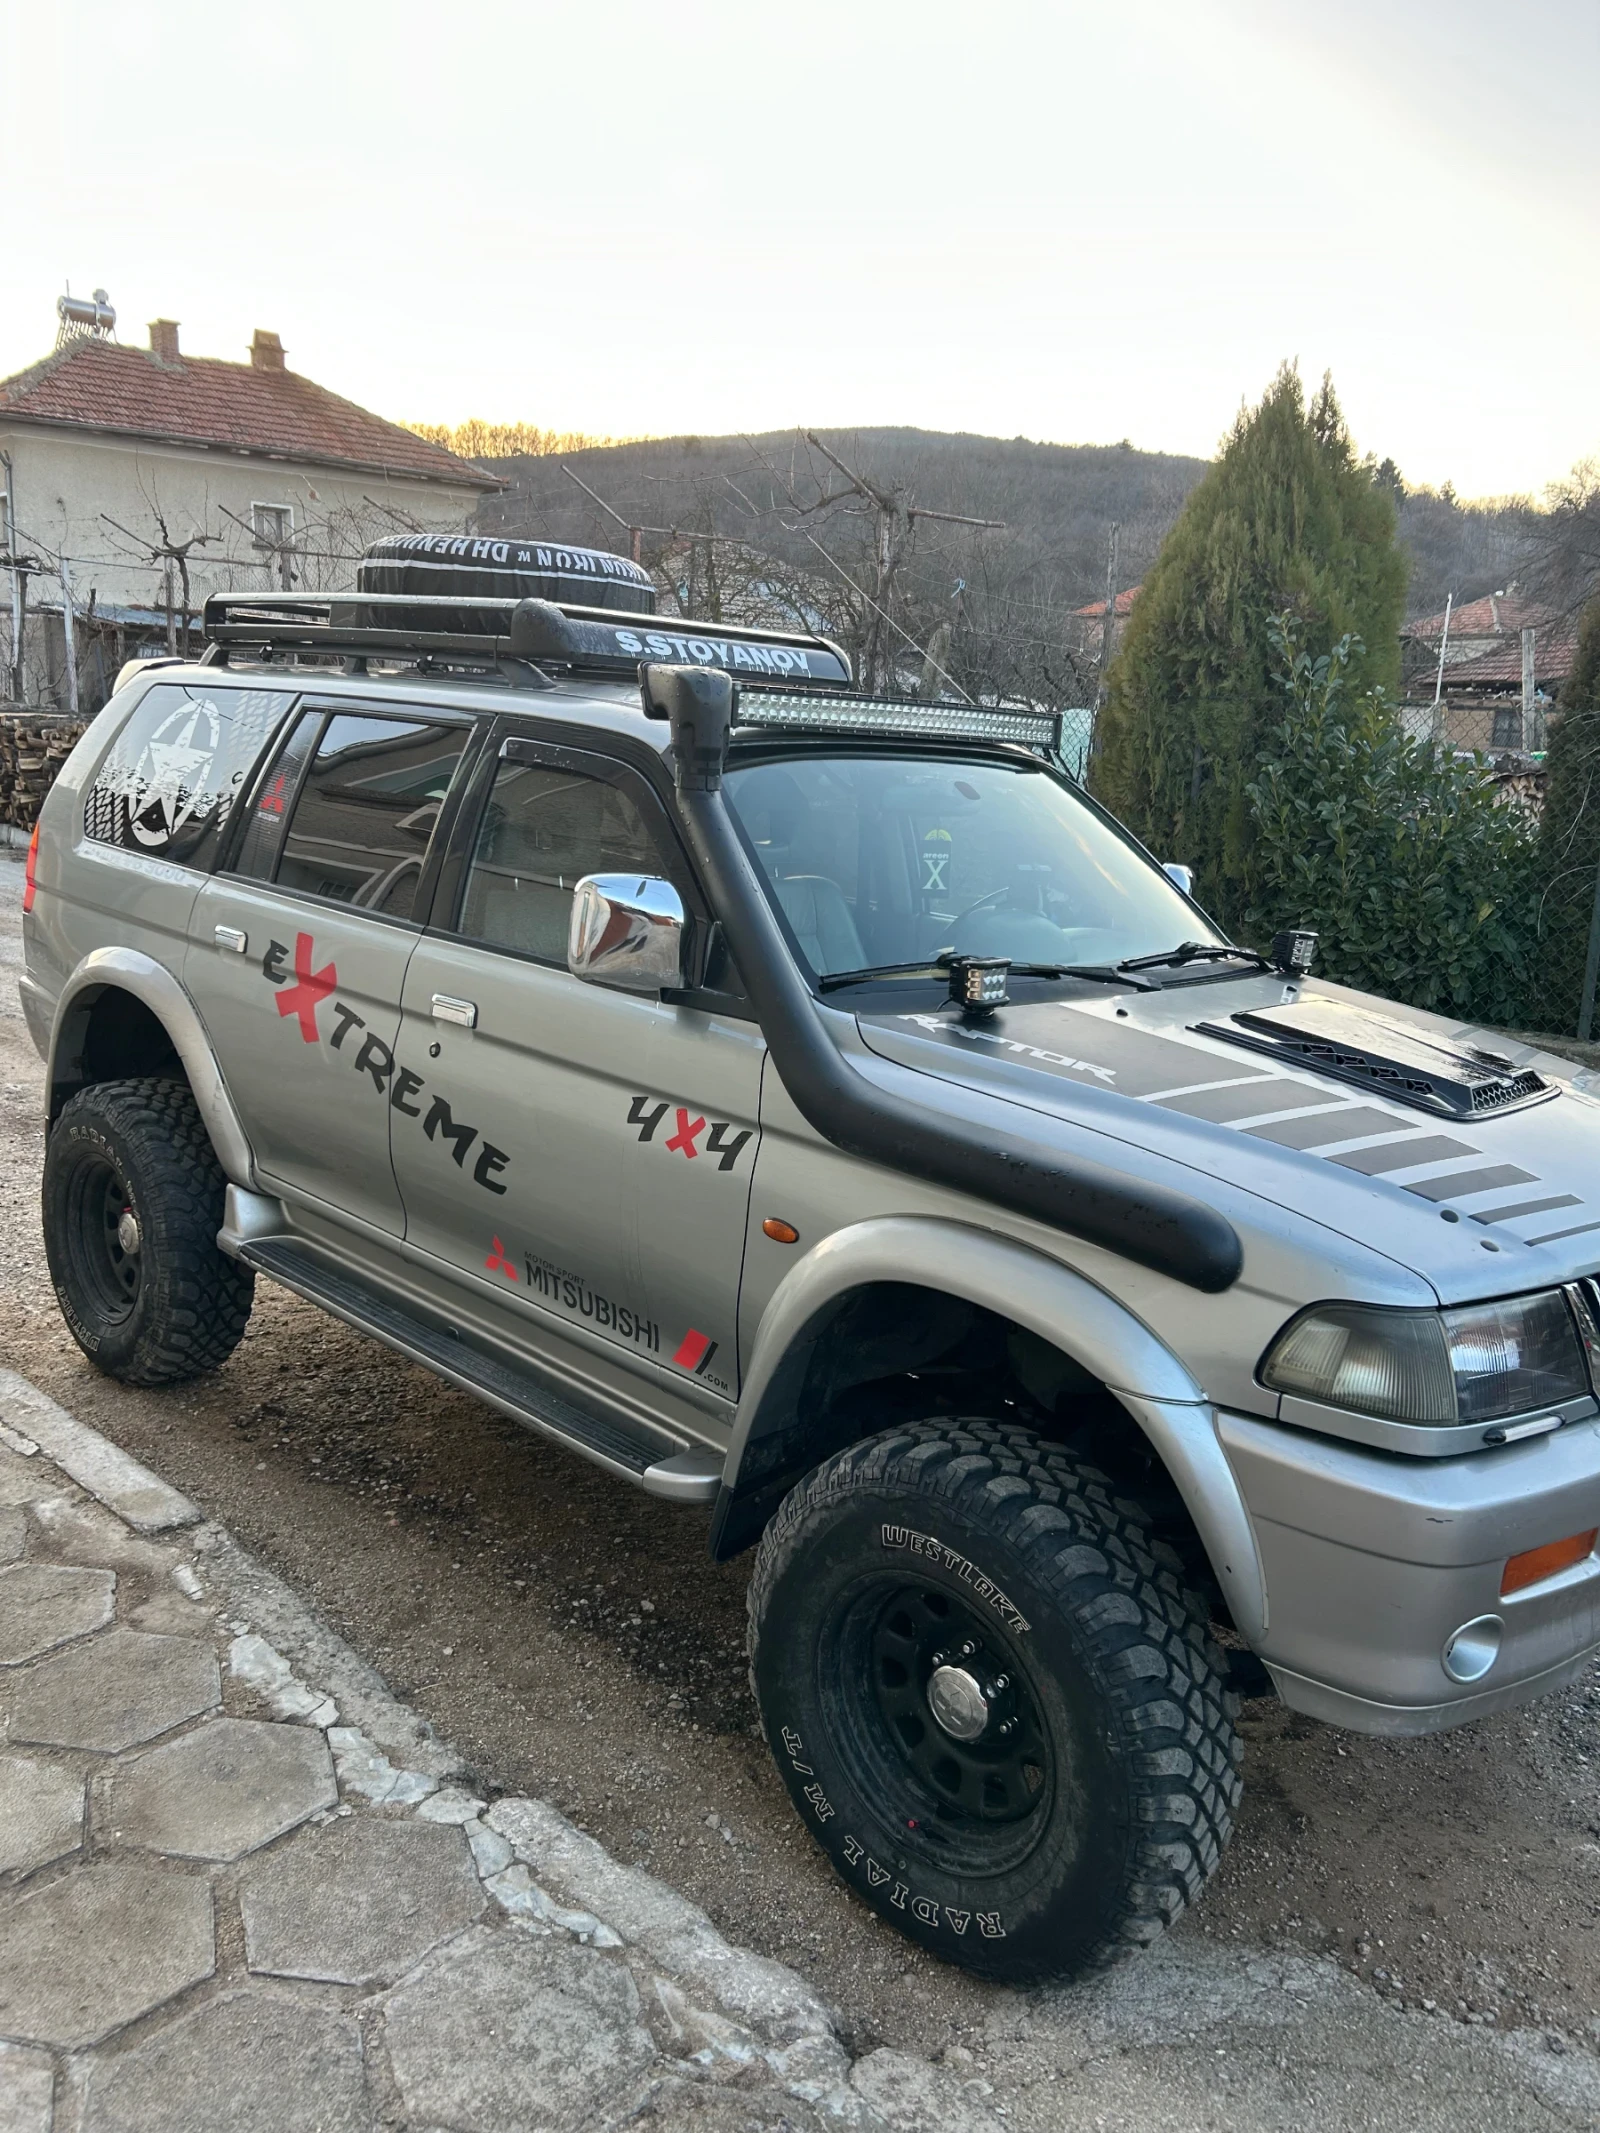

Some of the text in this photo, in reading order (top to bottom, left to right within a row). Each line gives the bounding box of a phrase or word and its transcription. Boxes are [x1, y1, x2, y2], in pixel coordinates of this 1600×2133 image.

[615, 631, 811, 678] S.STOYANOV
[922, 860, 948, 889] X
[897, 1014, 1117, 1085] RAPTOR
[525, 1260, 661, 1353] MITSUBISHI
[881, 1523, 1031, 1634] WESTLAKE
[781, 1726, 1007, 1939] RADIAL M/T
